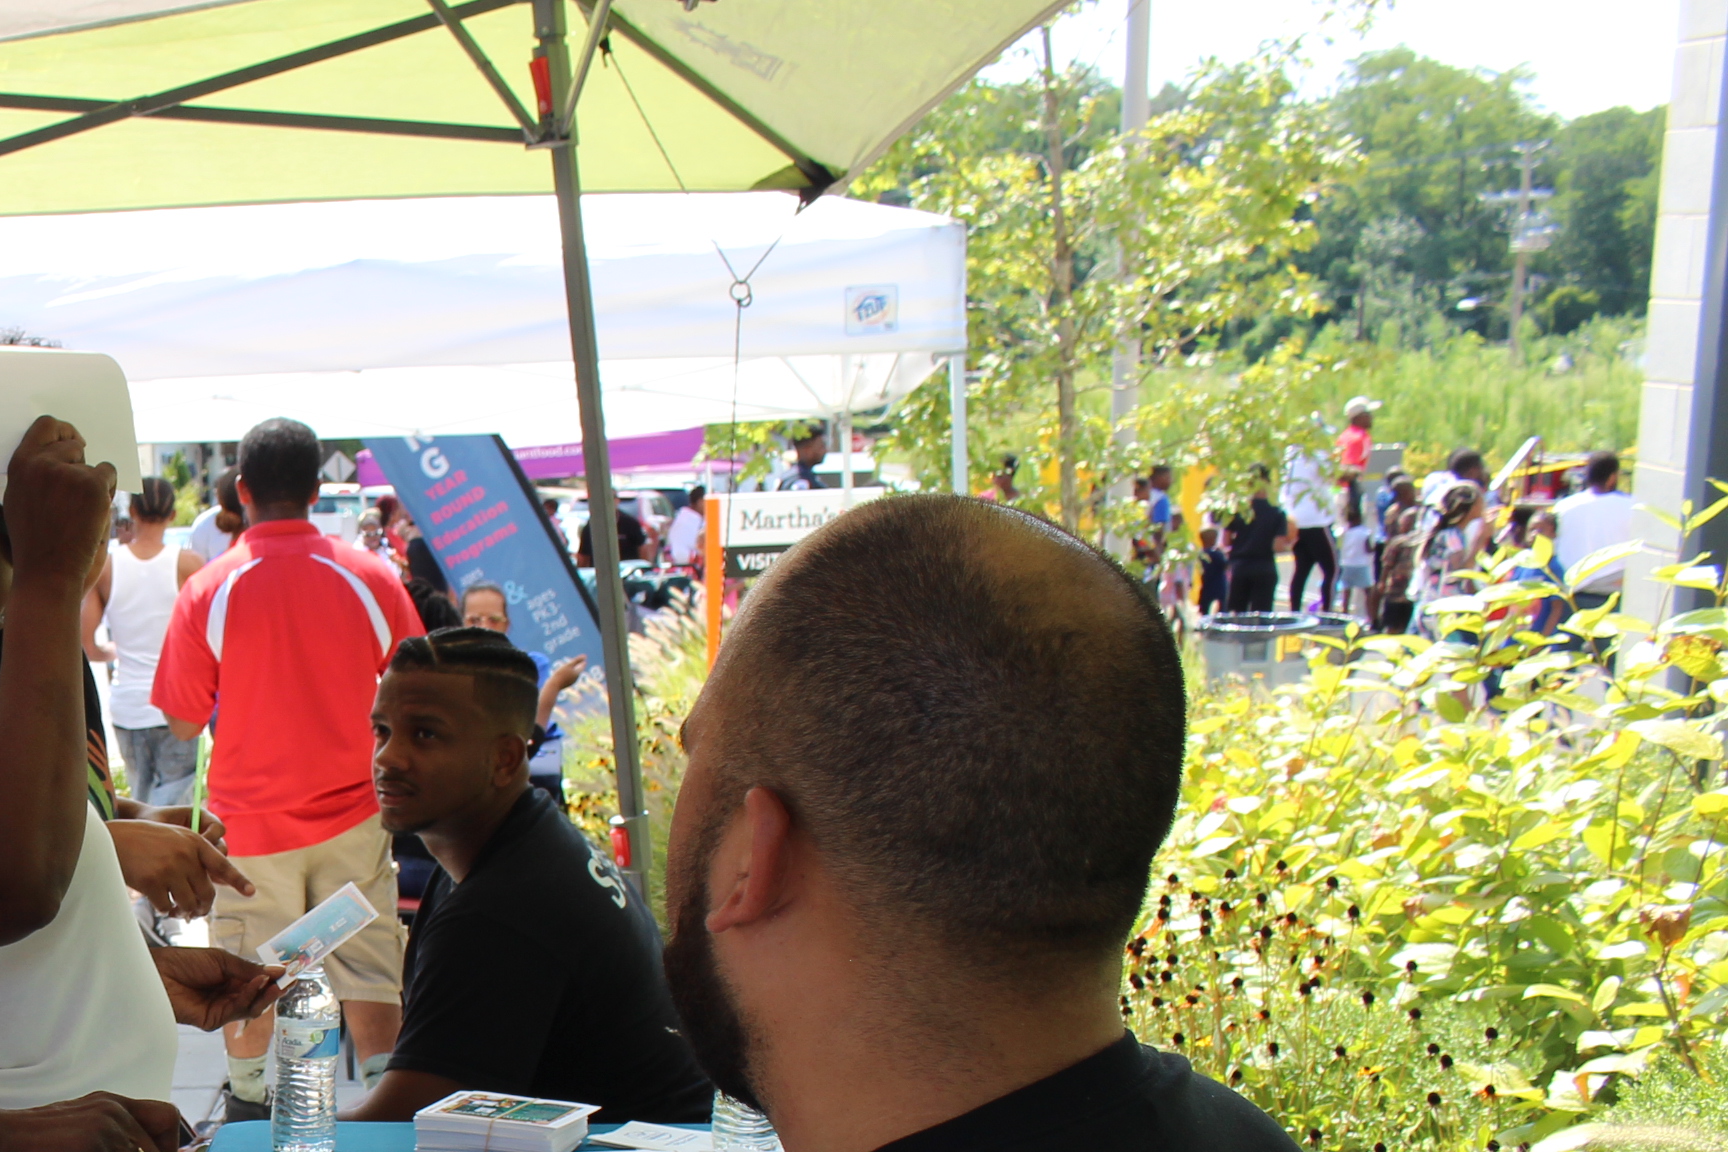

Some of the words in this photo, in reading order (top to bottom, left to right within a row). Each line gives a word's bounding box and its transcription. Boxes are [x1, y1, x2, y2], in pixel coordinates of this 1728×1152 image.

[425, 470, 468, 500] YEAR
[430, 486, 485, 525] ROUND
[432, 501, 509, 551] Education
[445, 522, 519, 569] Programs
[503, 580, 528, 605] &
[527, 588, 557, 611] ages
[542, 613, 568, 636] 2nd
[544, 626, 581, 654] grade
